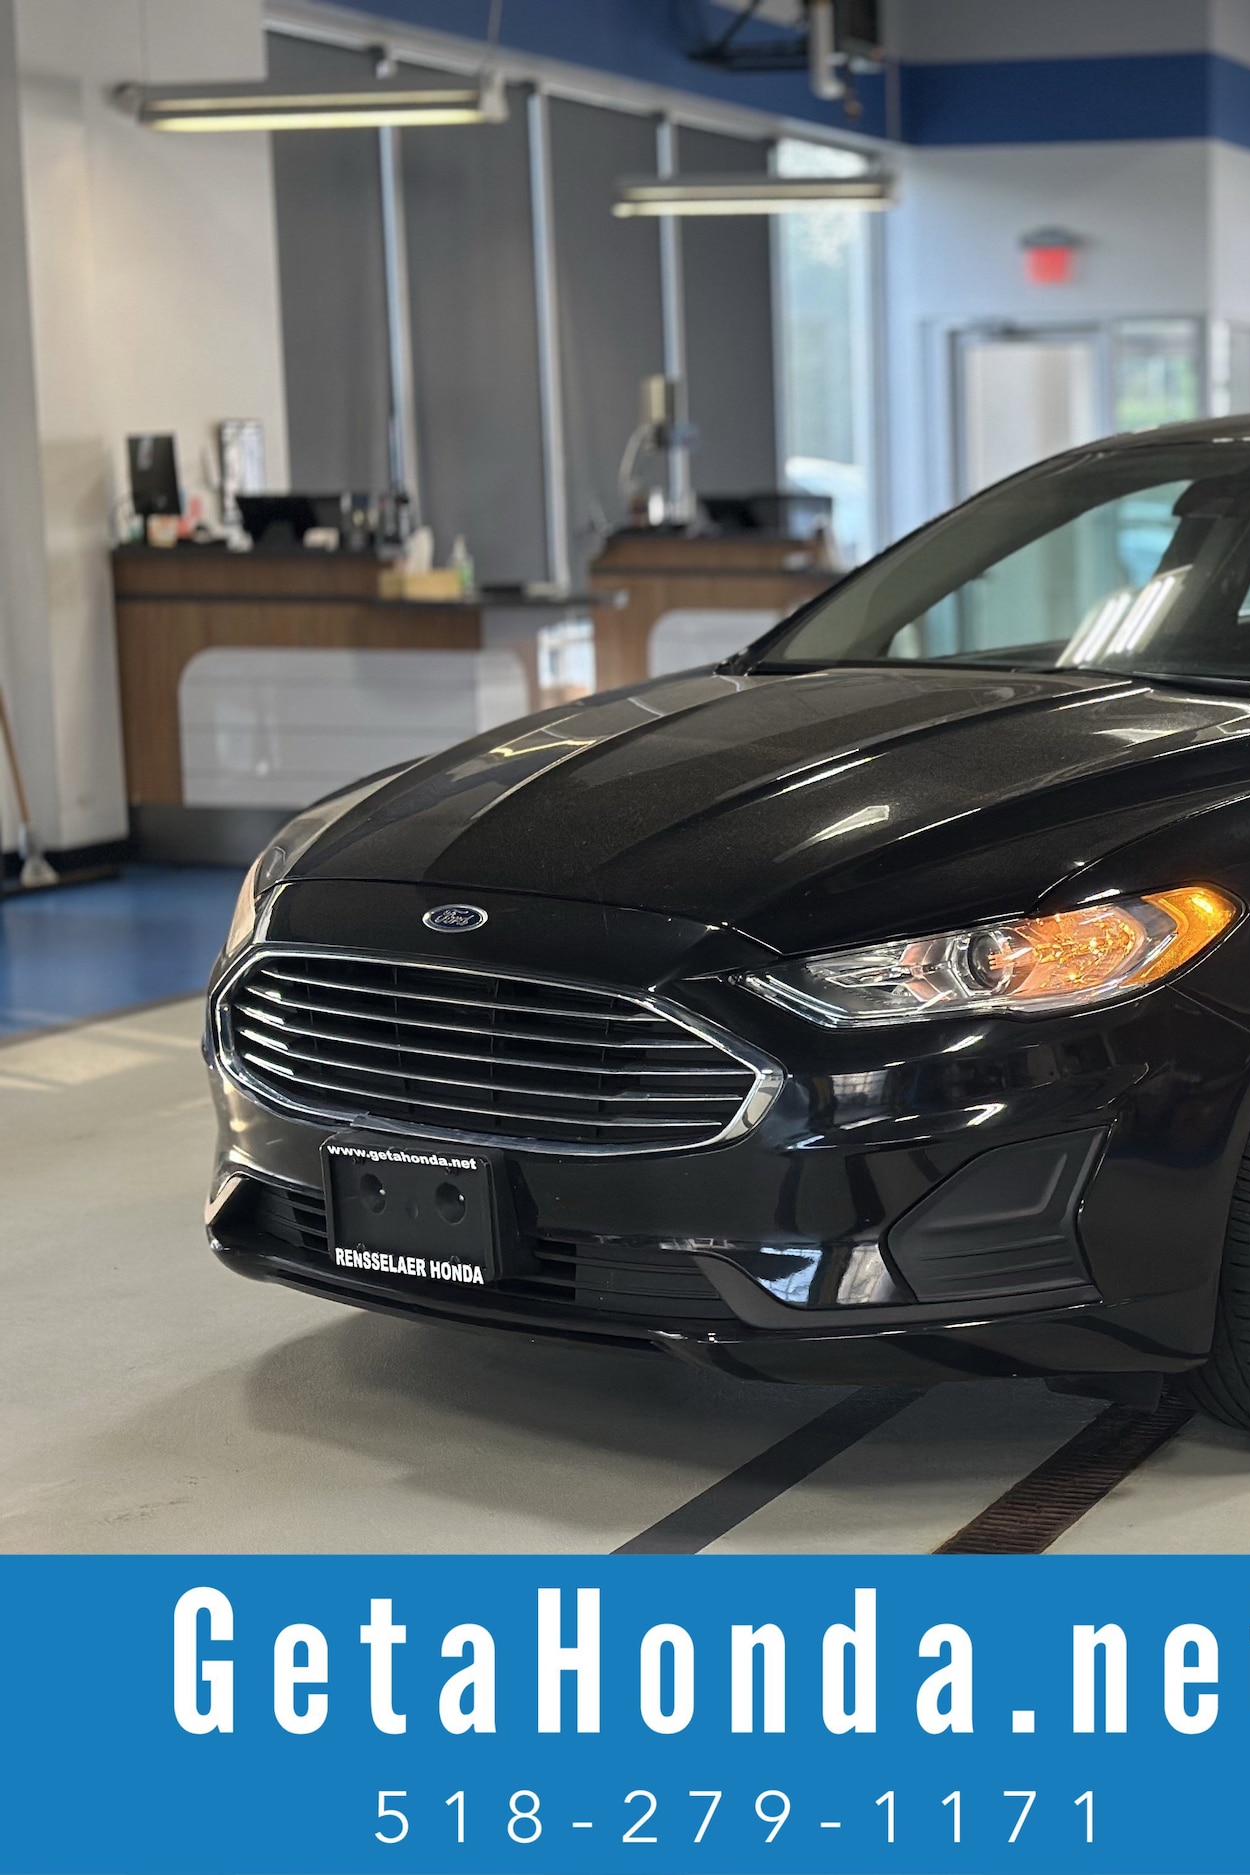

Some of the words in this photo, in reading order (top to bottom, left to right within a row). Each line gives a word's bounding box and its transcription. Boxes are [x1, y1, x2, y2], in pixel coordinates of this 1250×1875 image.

[434, 910, 475, 926] Ford
[327, 1145, 477, 1169] www.getahonda.net
[335, 1248, 427, 1277] RENSSELAER
[429, 1260, 484, 1284] HONDA
